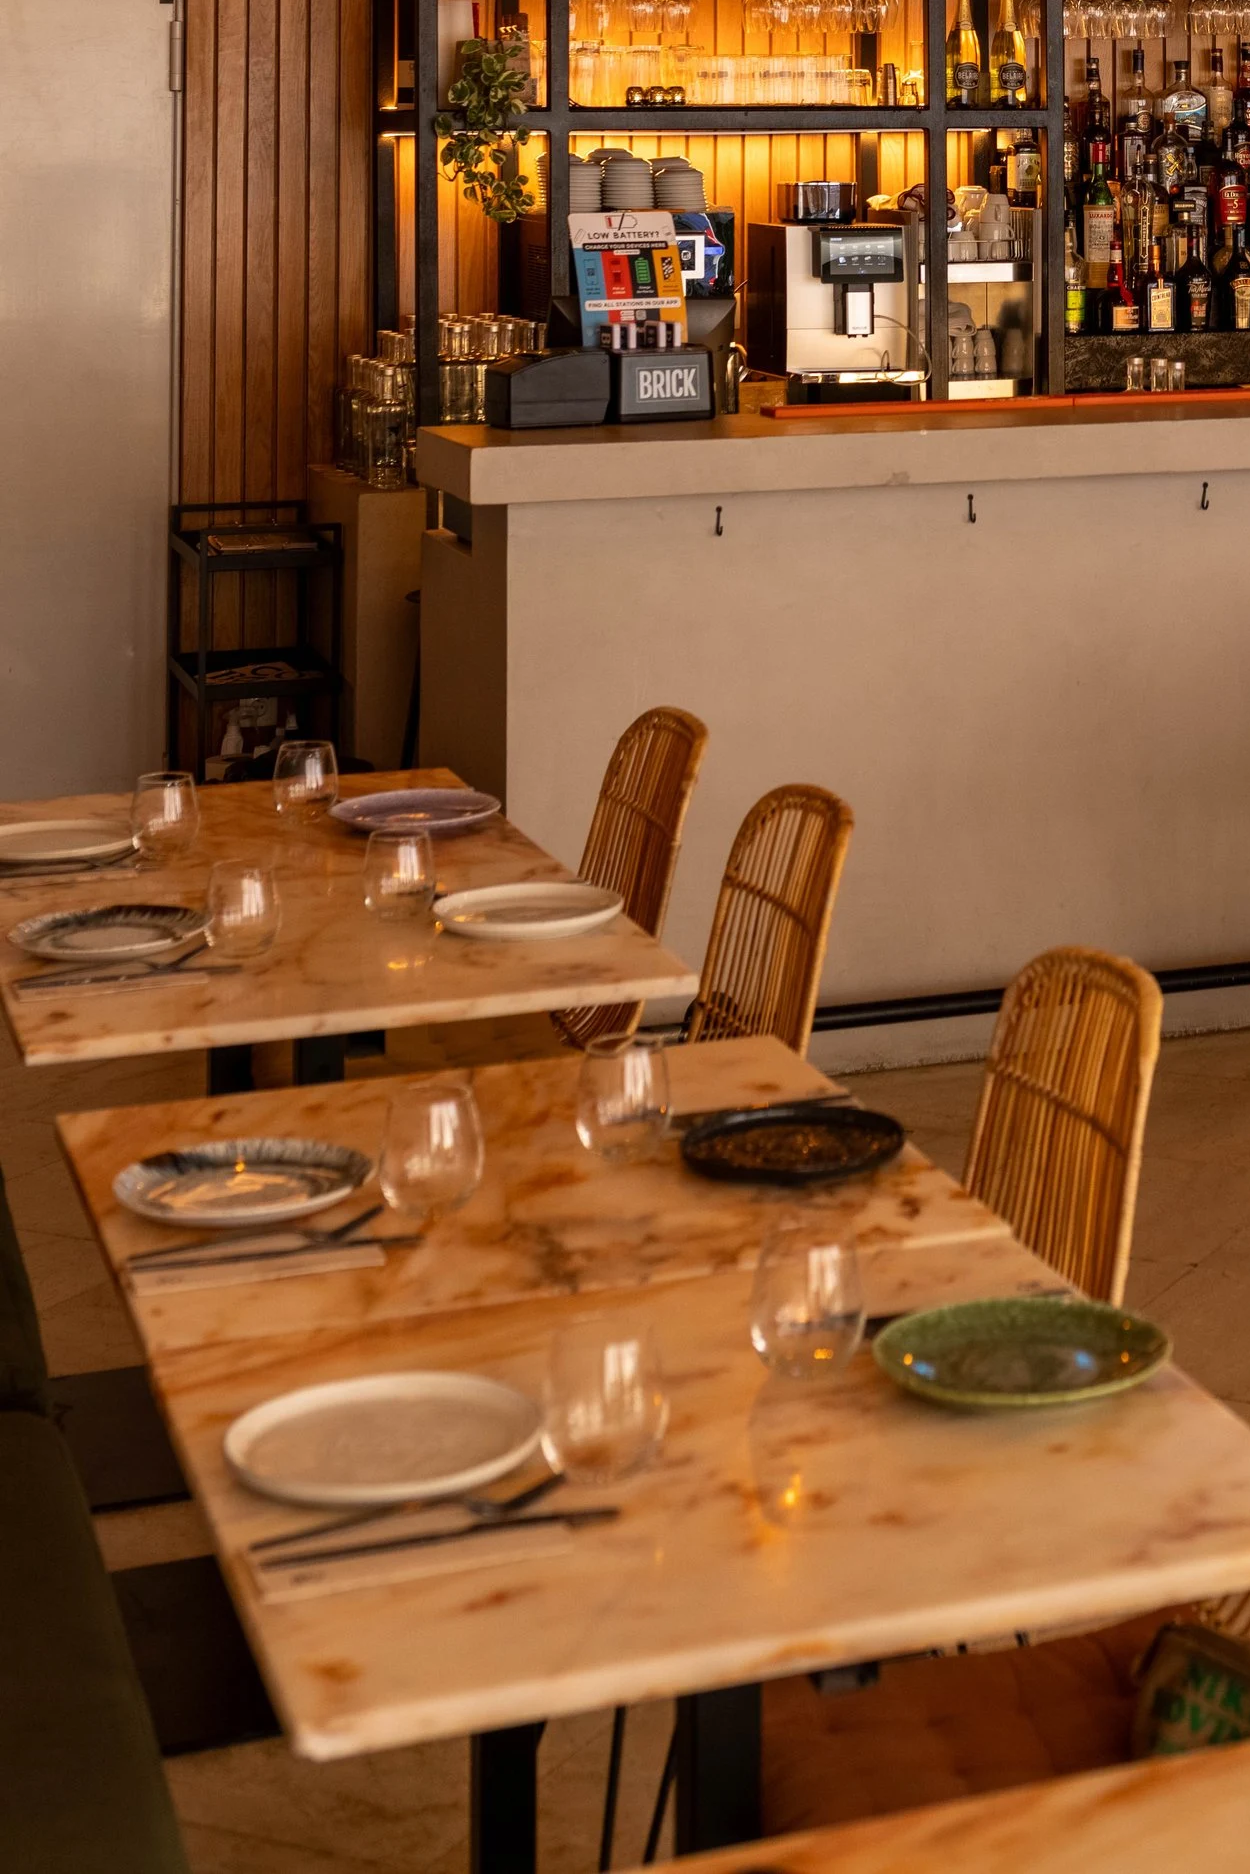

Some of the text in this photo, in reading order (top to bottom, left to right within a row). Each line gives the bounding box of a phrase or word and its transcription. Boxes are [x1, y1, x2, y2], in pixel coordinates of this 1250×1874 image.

[1233, 199, 1239, 209] 5
[587, 230, 660, 240] LOW BATTERY?
[640, 368, 697, 399] BRICK
